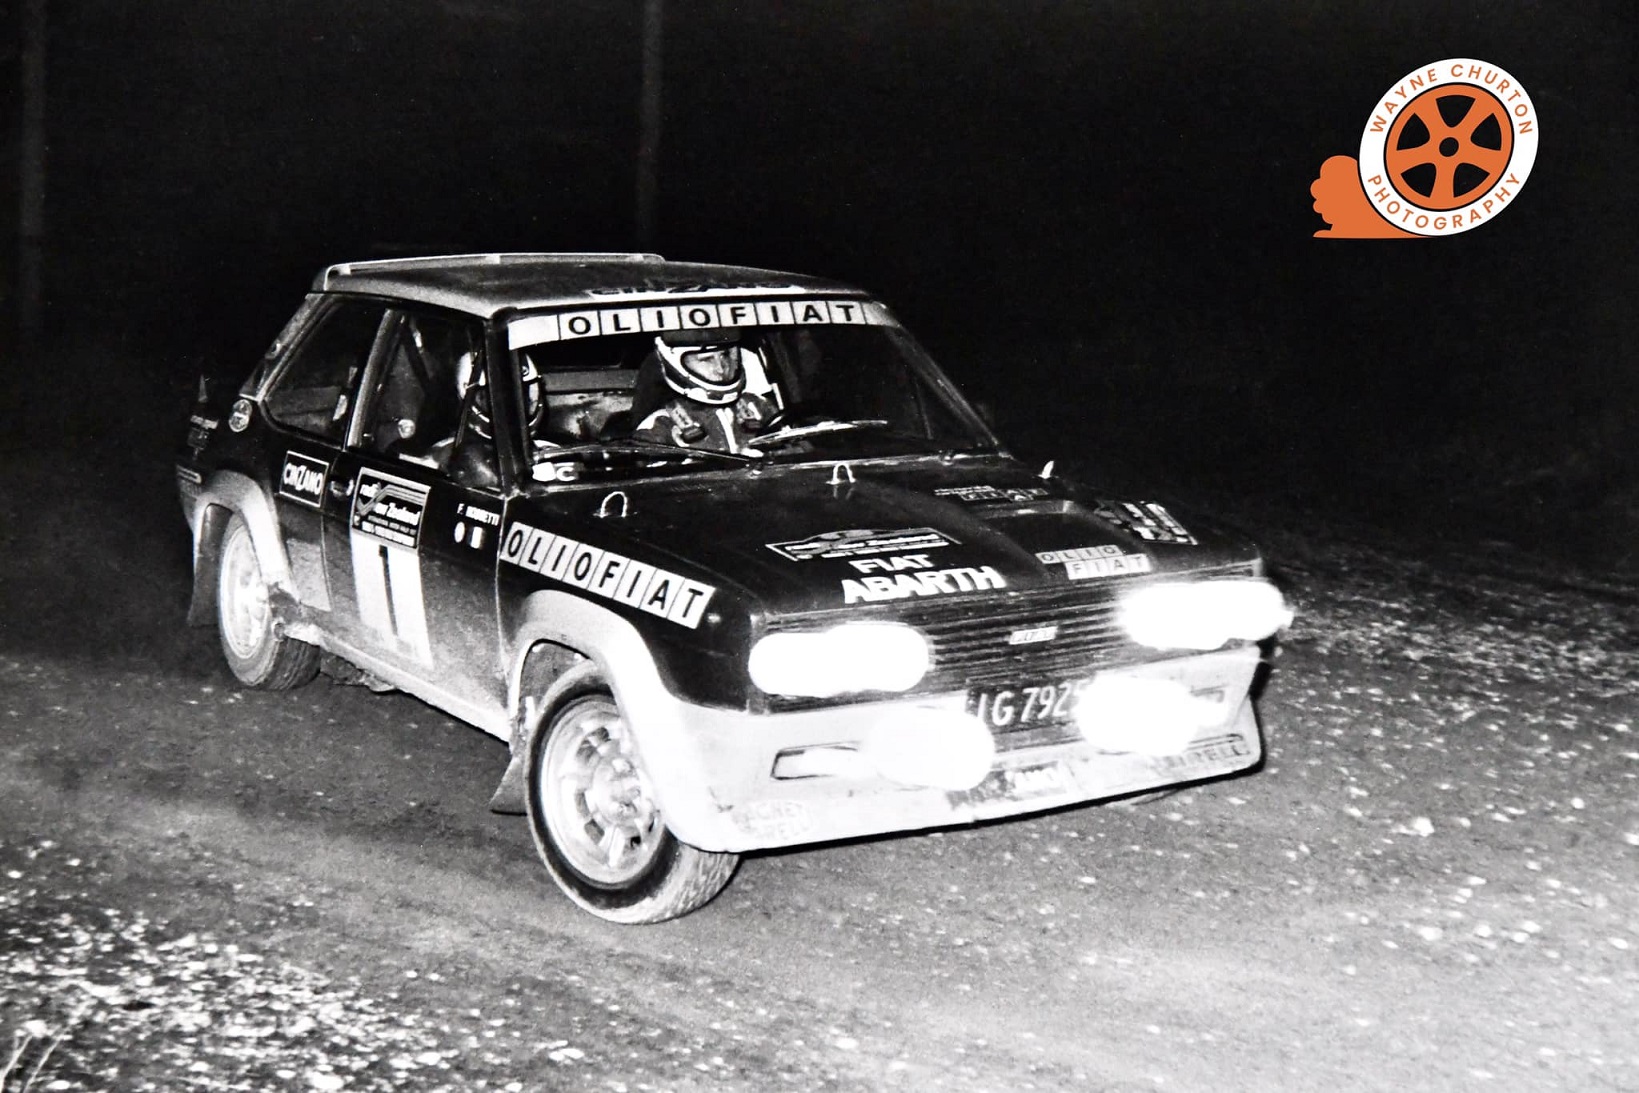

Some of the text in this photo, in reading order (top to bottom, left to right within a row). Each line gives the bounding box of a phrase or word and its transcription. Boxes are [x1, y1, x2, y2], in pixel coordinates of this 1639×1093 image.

[283, 462, 324, 495] CINZANO
[848, 554, 934, 573] FIAT
[1072, 555, 1143, 574] FIAT
[378, 544, 399, 636] 1
[841, 566, 1007, 604] ABARTH
